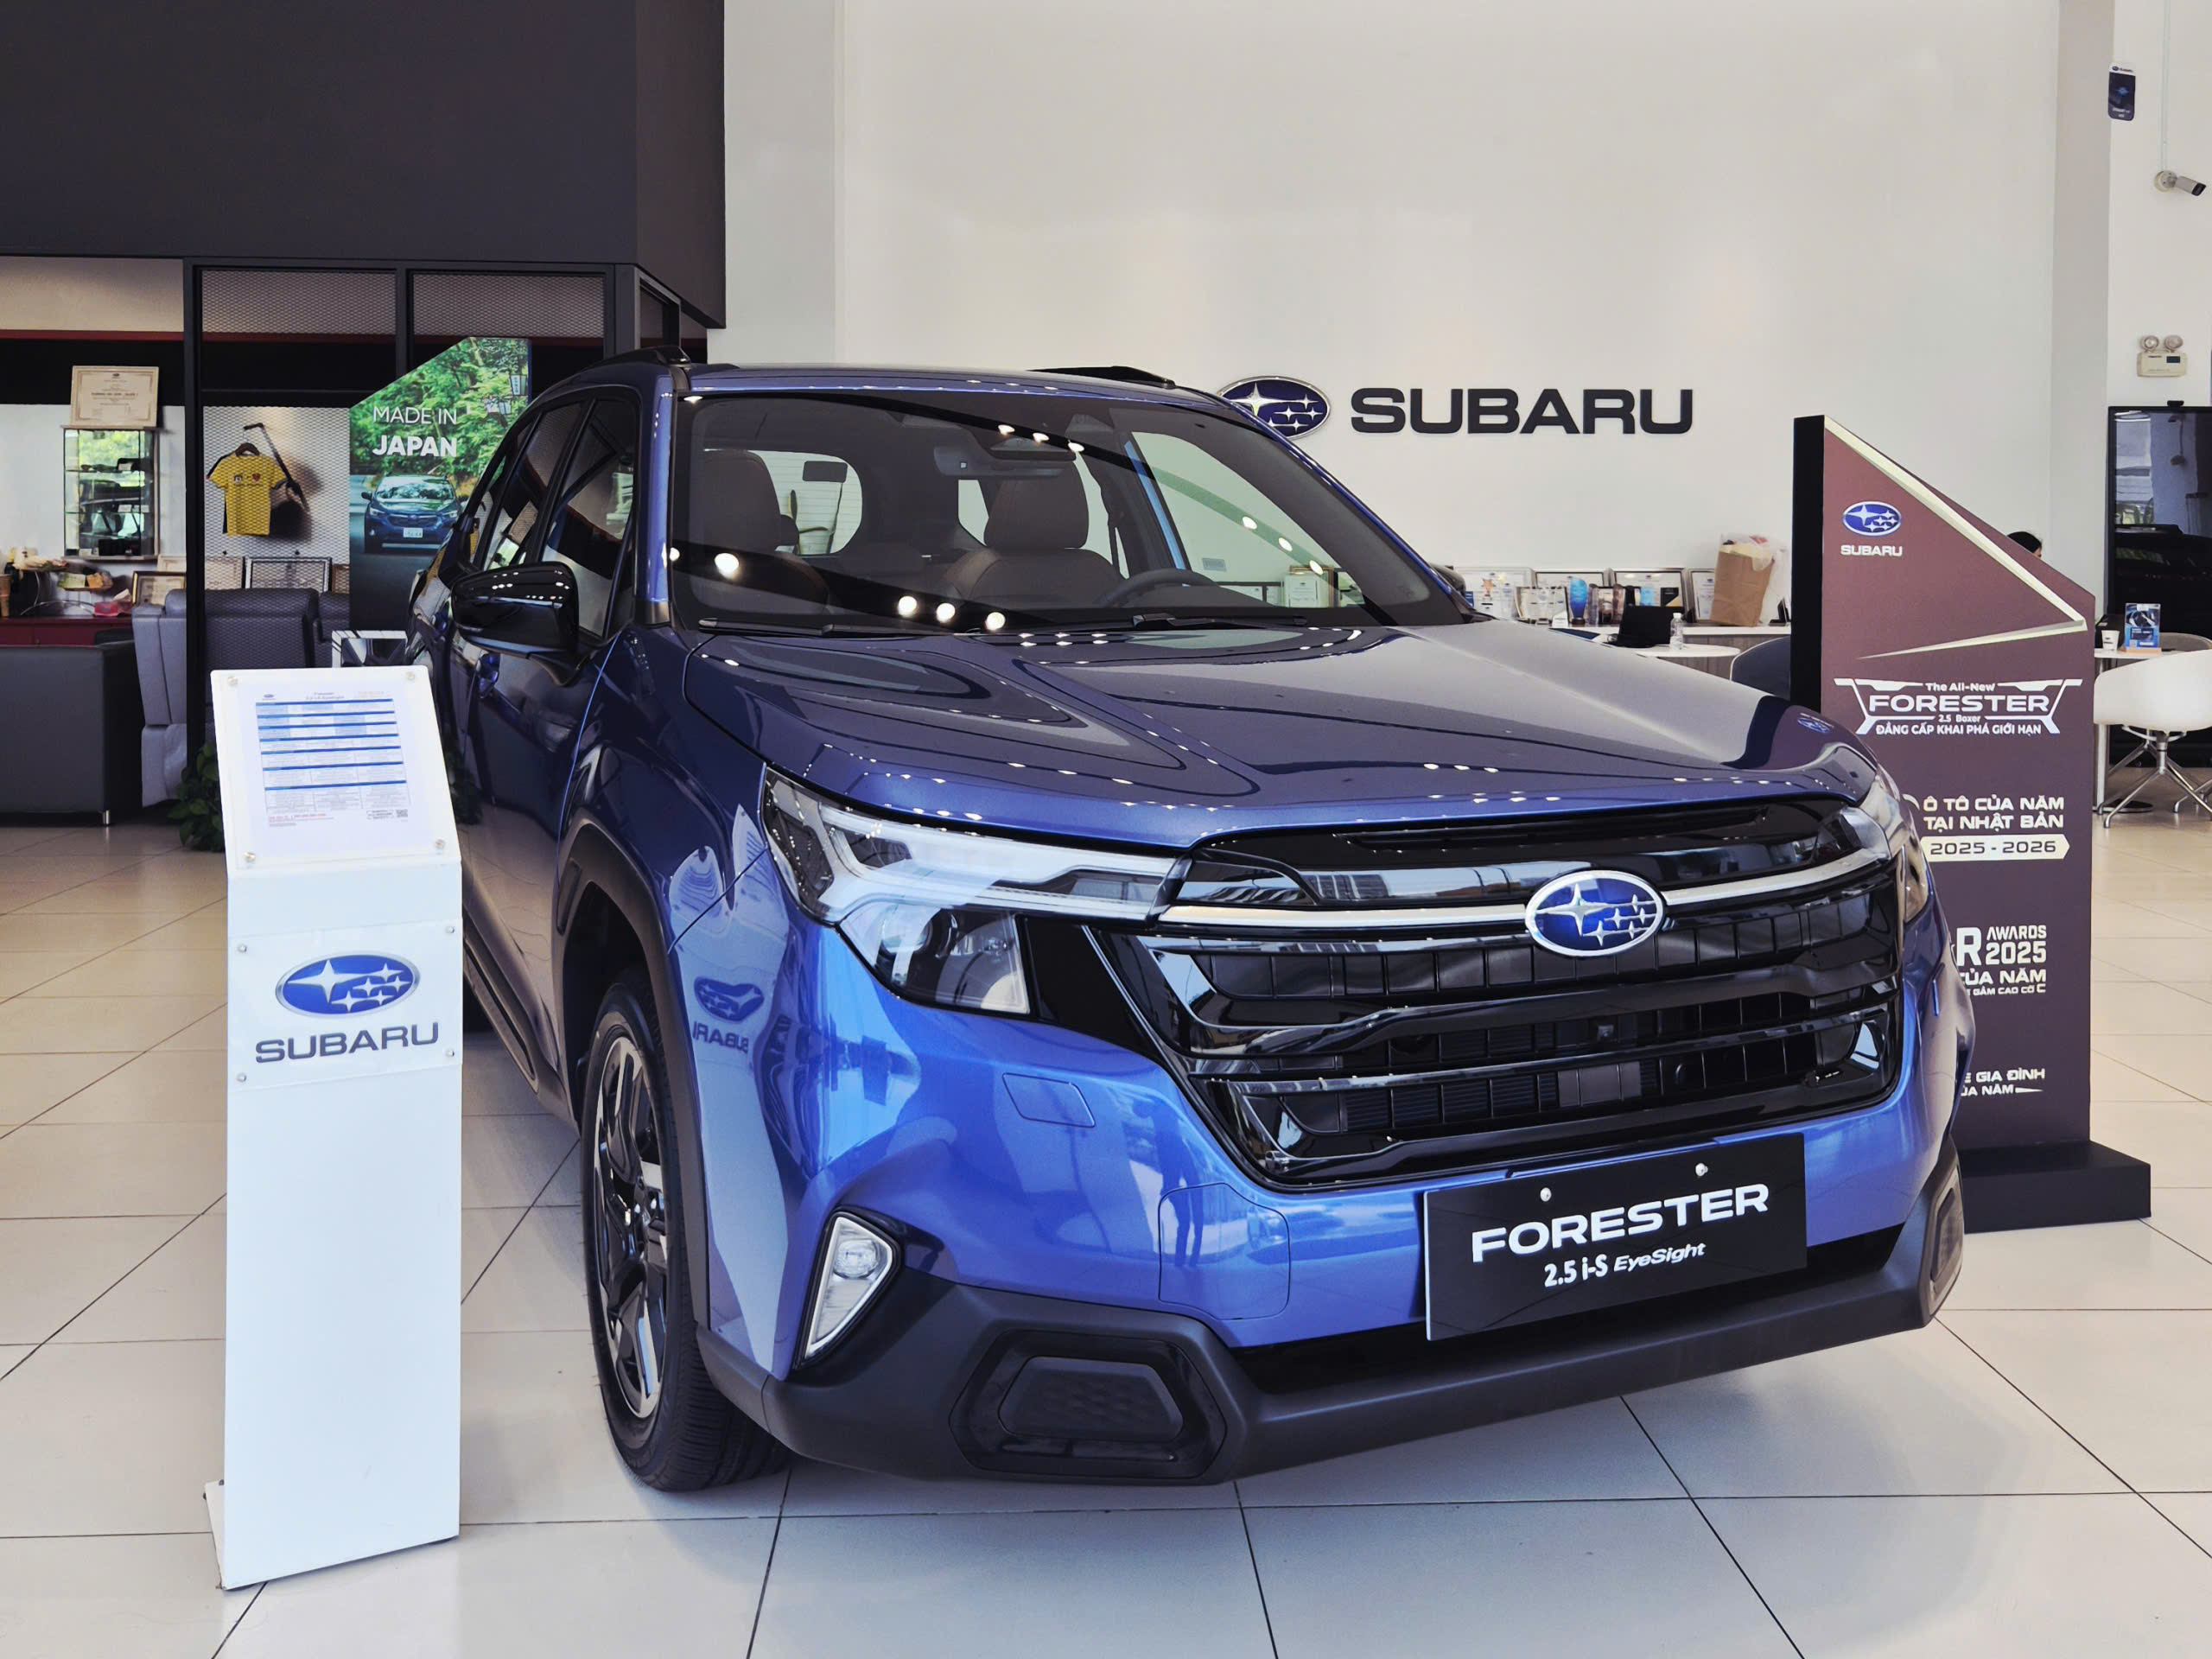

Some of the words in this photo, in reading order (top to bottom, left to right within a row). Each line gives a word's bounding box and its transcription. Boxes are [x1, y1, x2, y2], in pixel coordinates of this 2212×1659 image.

[373, 407, 432, 424] MADE
[438, 408, 457, 424] IN
[1351, 388, 1693, 435] SUBARU
[372, 435, 457, 457] JAPAN
[1840, 544, 1903, 556] SUBARU
[1926, 683, 1948, 691] The
[1949, 683, 1995, 691] All-New
[1869, 695, 2050, 712] FORESTER
[1911, 722, 1935, 734] CẤP
[1936, 724, 1963, 734] KHAI
[1967, 722, 1989, 734] PHÁ
[1992, 722, 2016, 734] GIỚI
[2018, 724, 2041, 736] HẠN
[1923, 795, 1938, 811] Ô
[1943, 795, 1969, 810] TÔ
[1974, 794, 2014, 810] CỦA
[2020, 795, 2064, 810] NĂM
[1923, 816, 1953, 833] TẠI
[1960, 812, 2014, 832] NHẬT
[2020, 810, 2063, 829] BẢN
[1930, 842, 1986, 855] 2025
[2002, 841, 2056, 853] 2026
[1986, 925, 2046, 940] AWARDS
[1952, 927, 1981, 966] R
[1986, 941, 2046, 965] 2025
[1999, 968, 2046, 984] NĂM
[2037, 983, 2046, 993] C
[255, 1022, 439, 1063] SUBARU
[1976, 1071, 2003, 1083] GIA
[2006, 1067, 2045, 1081] ĐÌNH
[1471, 1183, 1769, 1262] FORESTER
[1544, 1264, 1577, 1287] 2.5
[1581, 1254, 1610, 1281] i-S
[1613, 1242, 1707, 1274] EyeSight
